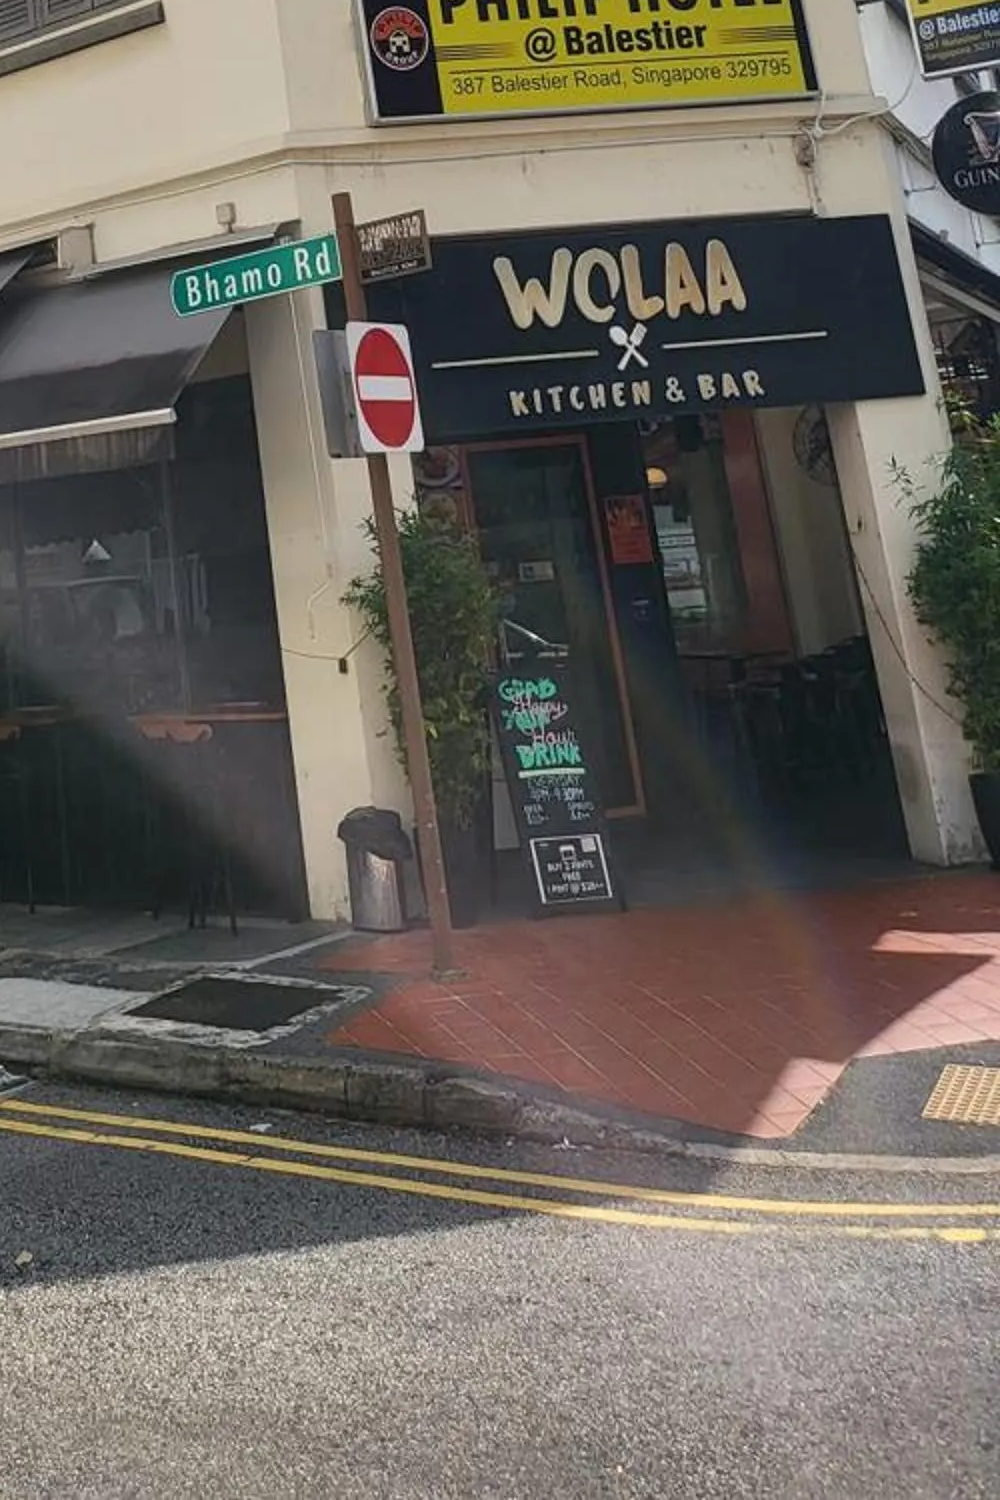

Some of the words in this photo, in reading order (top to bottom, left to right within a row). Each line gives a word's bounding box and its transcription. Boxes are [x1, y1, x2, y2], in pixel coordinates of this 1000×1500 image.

[525, 28, 557, 62] @
[564, 22, 706, 56] Balestier
[920, 20, 935, 40] @
[936, 7, 1000, 35] Balestie
[453, 77, 484, 96] 387
[492, 72, 568, 93] Balestier
[574, 68, 627, 90] Road,
[632, 64, 721, 88] Singapore
[726, 58, 791, 80] 329795
[185, 263, 281, 307] Bhamo
[293, 242, 331, 281] Rd
[493, 238, 746, 329] WOLAA
[509, 380, 652, 416] KITCHEN
[665, 376, 686, 403] &
[698, 369, 765, 401] BAR
[516, 743, 582, 768] DRINK
